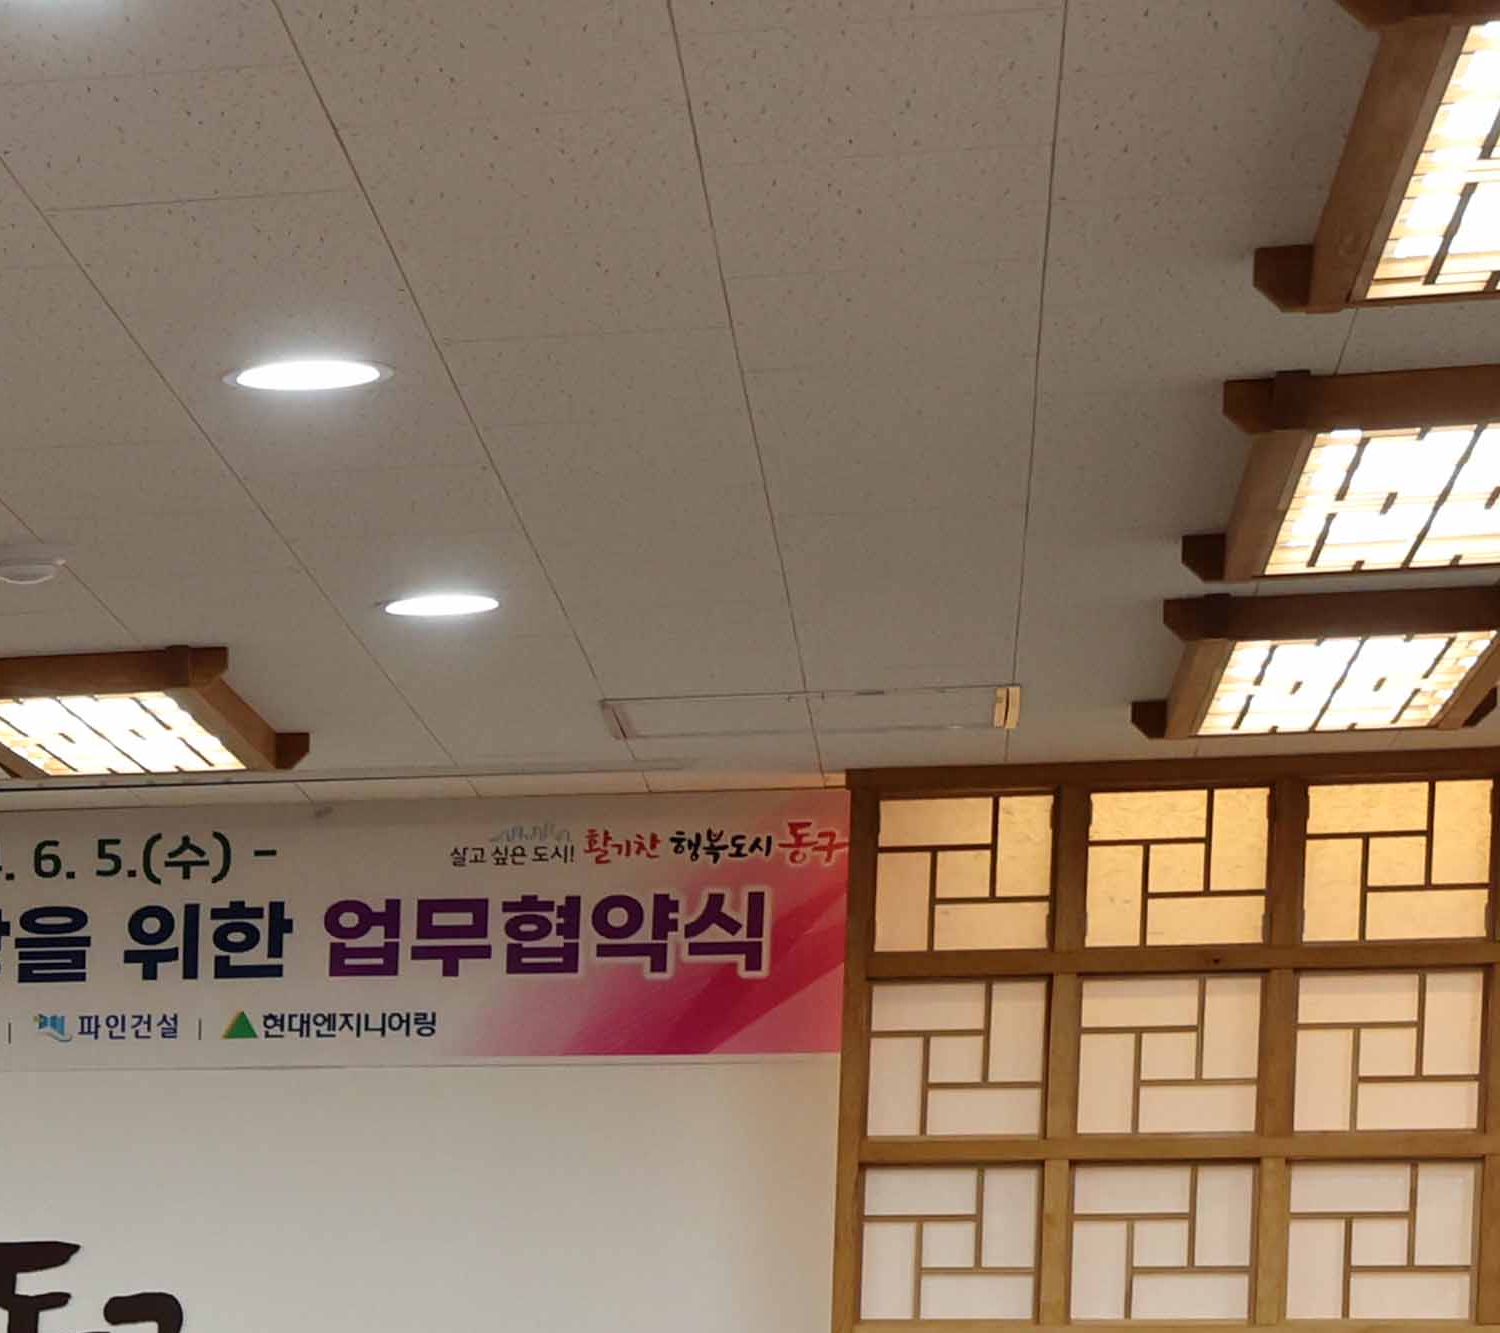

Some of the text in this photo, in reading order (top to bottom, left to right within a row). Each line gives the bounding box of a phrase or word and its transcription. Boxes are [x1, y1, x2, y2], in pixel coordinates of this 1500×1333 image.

[34, 840, 75, 879] 6.
[96, 832, 231, 884] 5.(수)
[451, 845, 574, 866] 살고 싶은 도시!
[584, 822, 848, 864] 활기찬 행복도시 동구
[124, 901, 293, 980] 위한
[324, 891, 768, 980] 업무협약식
[79, 1014, 177, 1039] 파인건설
[263, 1012, 436, 1038] 현대엔지니어링
